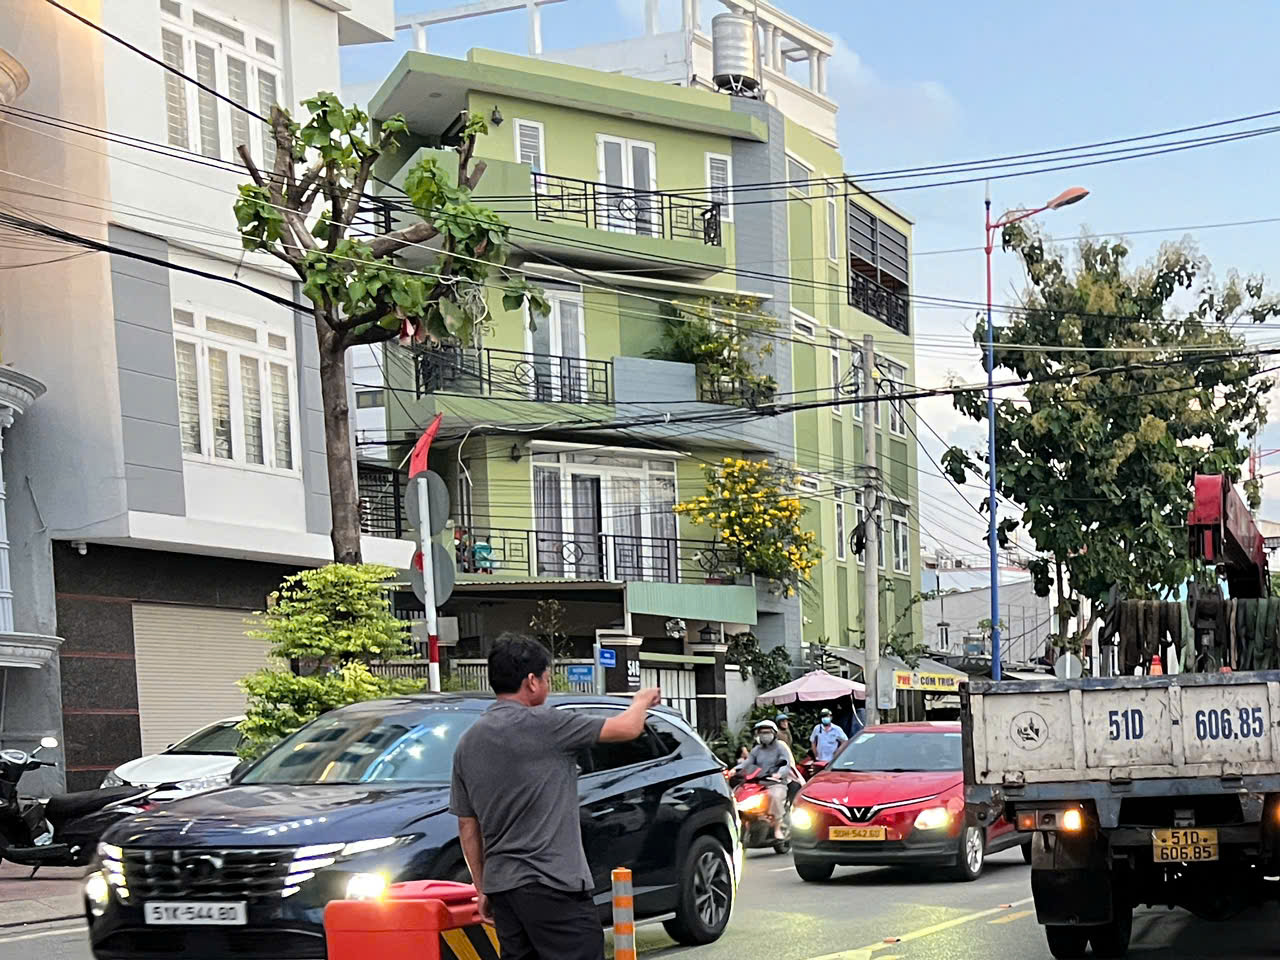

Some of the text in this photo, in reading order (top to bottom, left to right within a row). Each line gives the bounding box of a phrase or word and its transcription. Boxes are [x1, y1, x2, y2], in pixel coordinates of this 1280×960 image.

[1108, 708, 1145, 741] 51D
[1195, 707, 1264, 741] 606.85
[1171, 831, 1199, 845] 51D
[1160, 845, 1212, 861] 606.85
